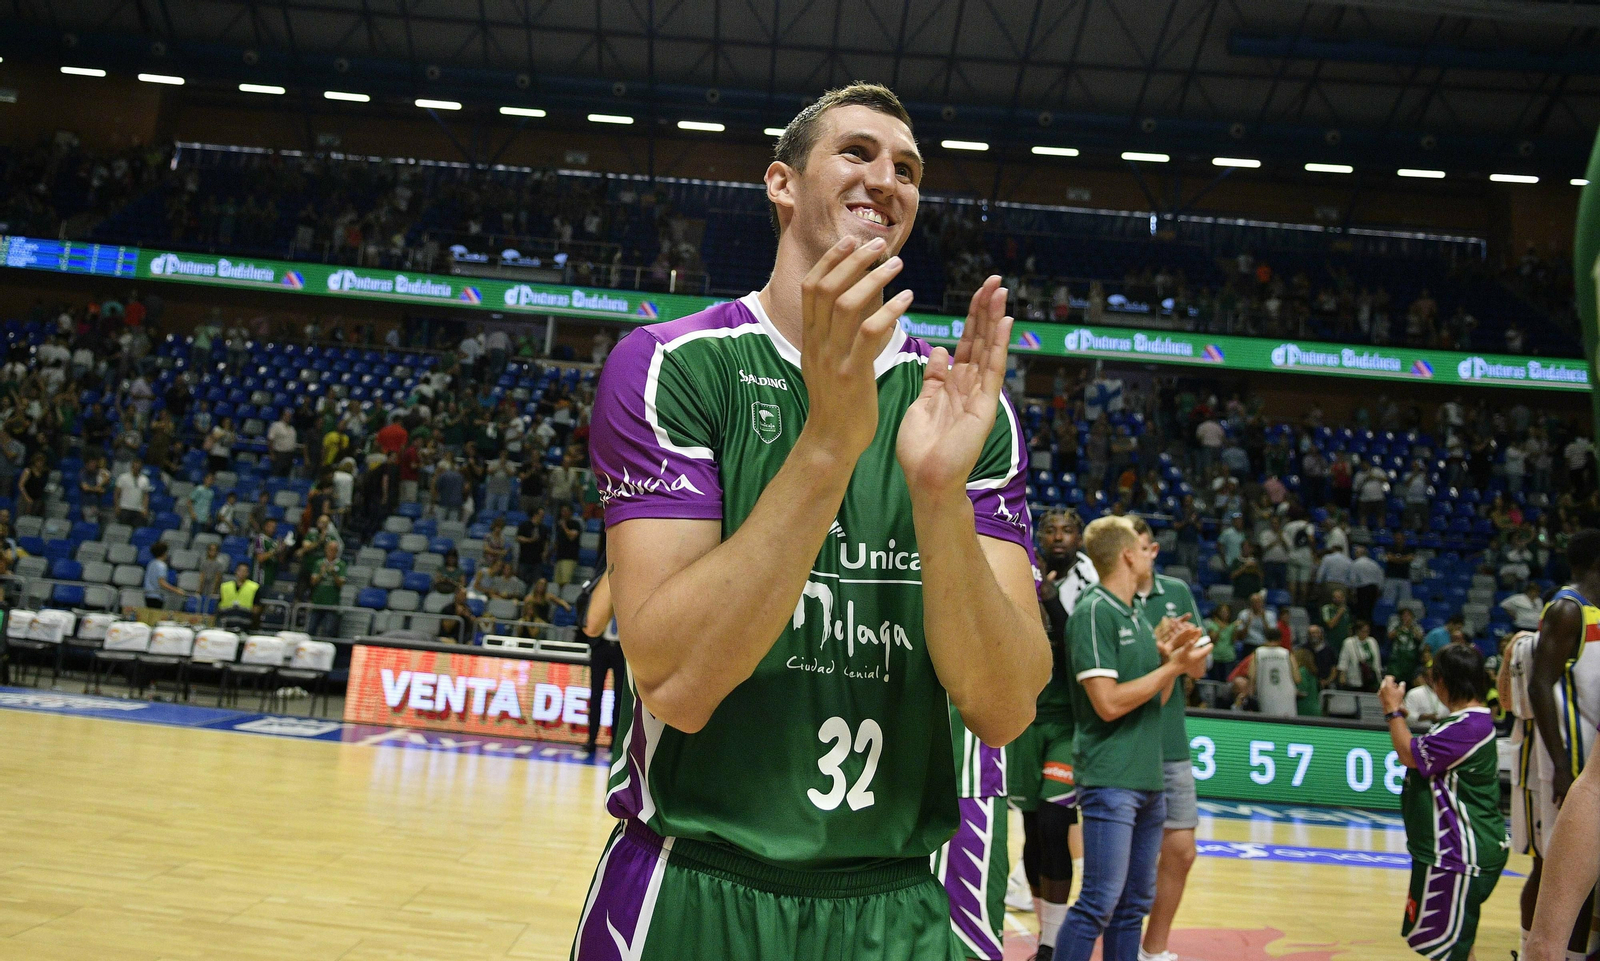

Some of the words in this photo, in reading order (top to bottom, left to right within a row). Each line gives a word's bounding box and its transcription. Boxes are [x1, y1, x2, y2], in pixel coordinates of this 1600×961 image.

[840, 538, 921, 571] Unica
[786, 656, 835, 674] Ciudad
[381, 669, 522, 718] VENTA
[806, 716, 883, 811] 32
[1250, 740, 1314, 787] 57
[1346, 748, 1407, 795] 08
